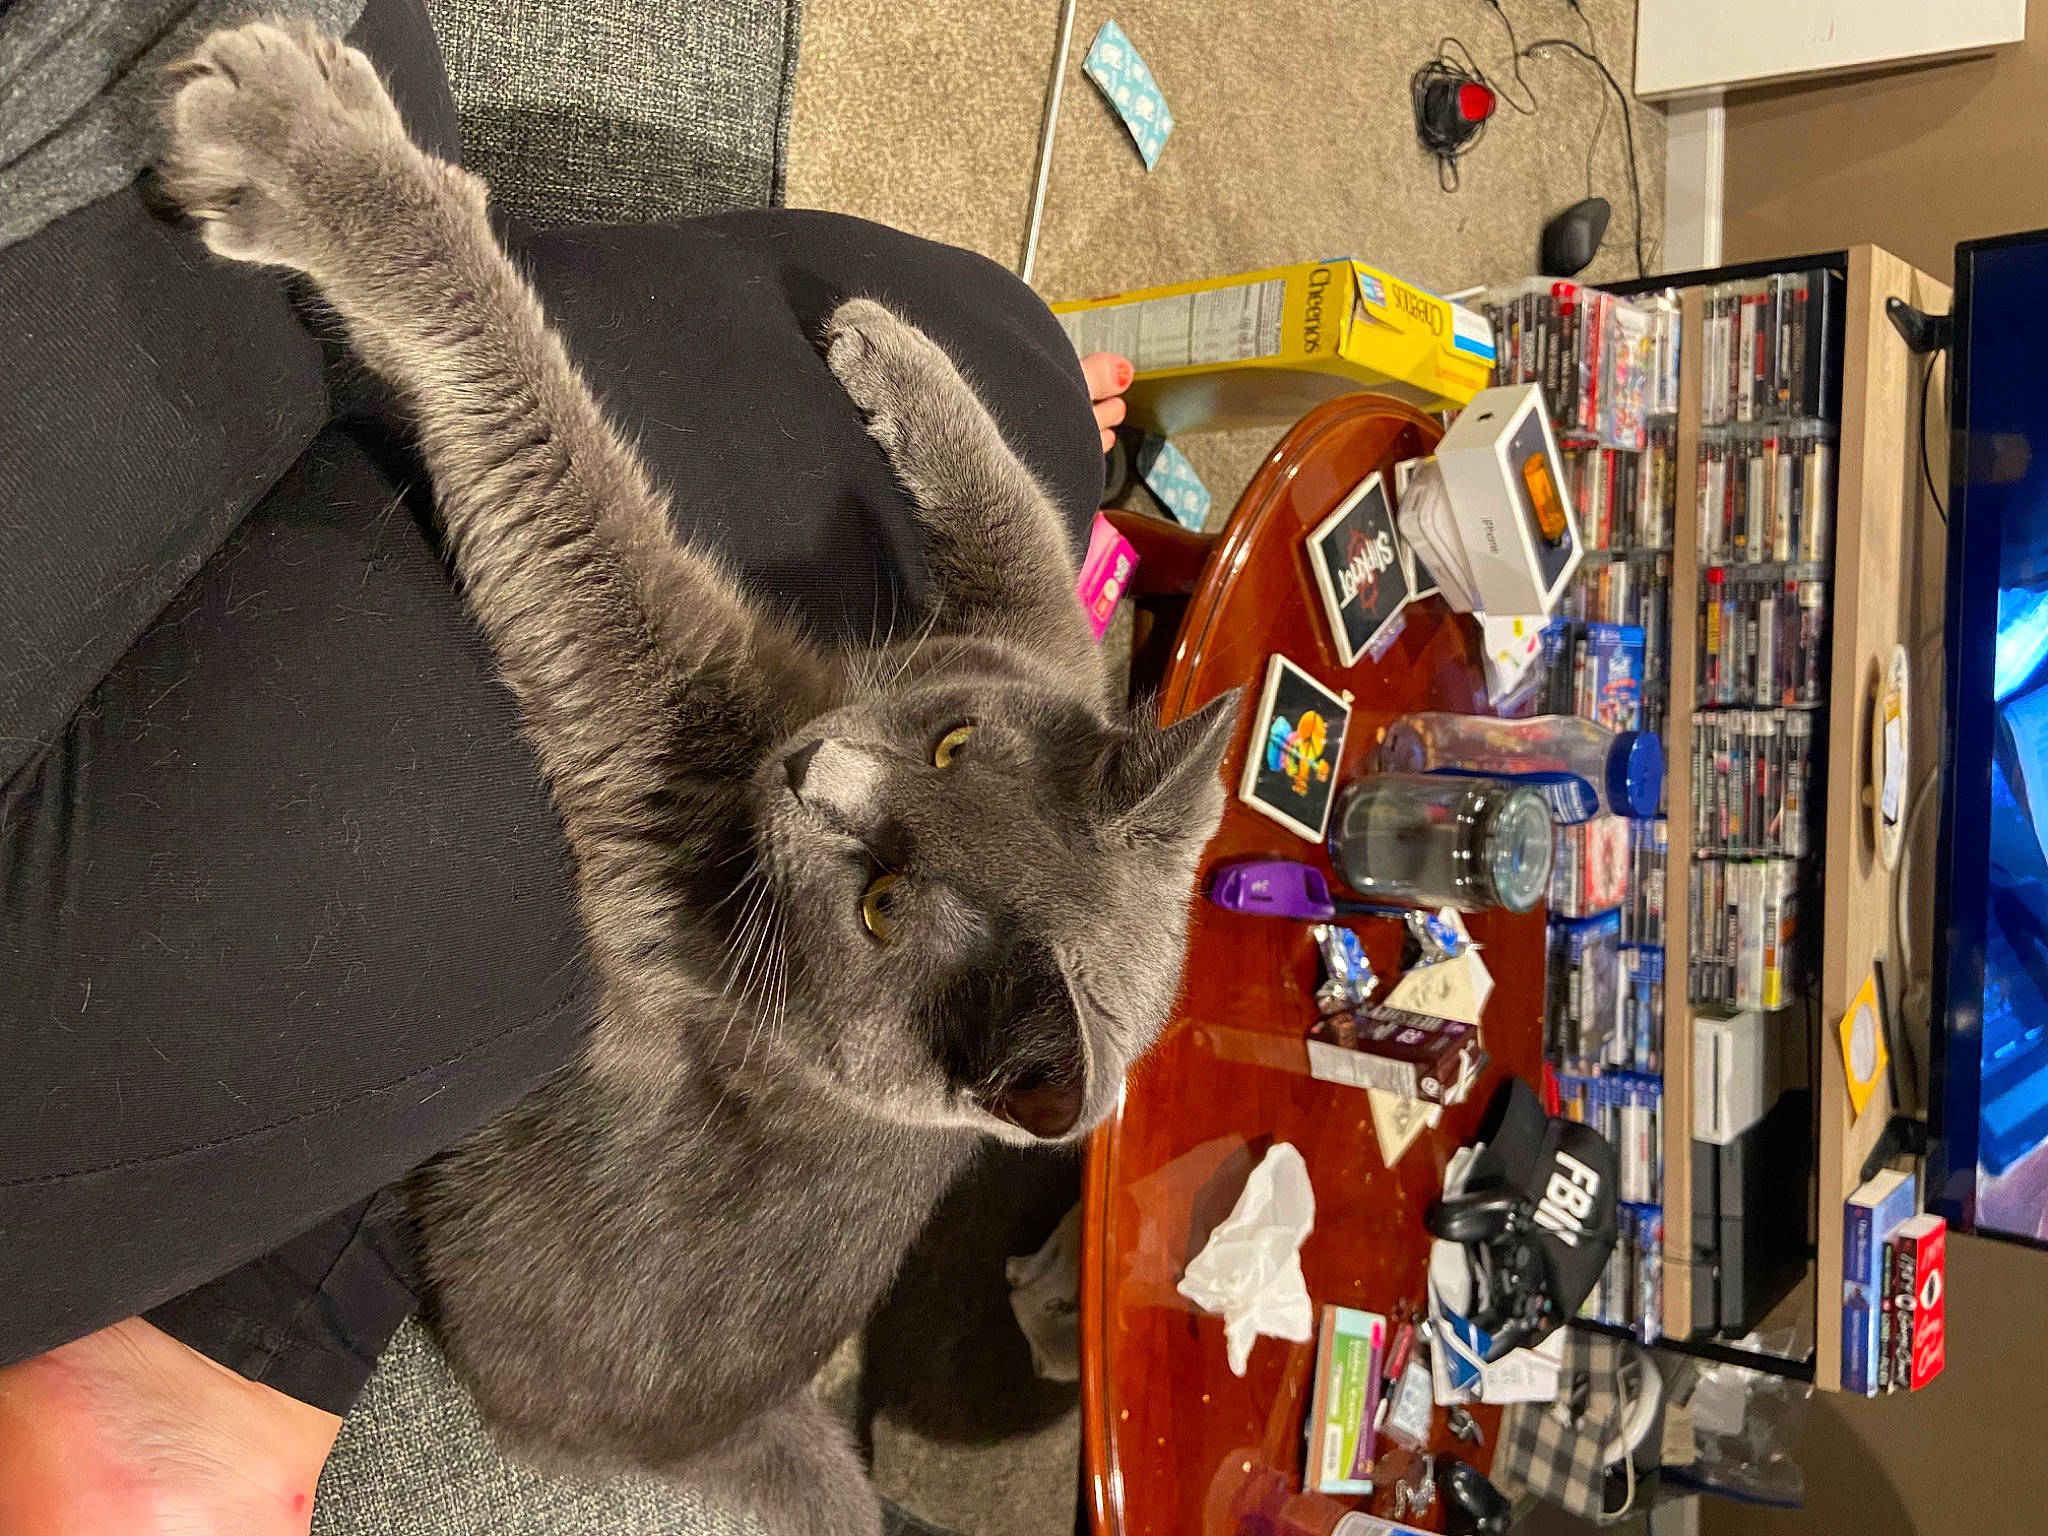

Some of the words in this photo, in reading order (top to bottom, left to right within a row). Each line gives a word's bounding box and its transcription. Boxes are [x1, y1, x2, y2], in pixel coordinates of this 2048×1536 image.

[1303, 269, 1332, 354] Cheerios
[1392, 283, 1443, 337] Cheerios
[1481, 517, 1499, 554] iPhone
